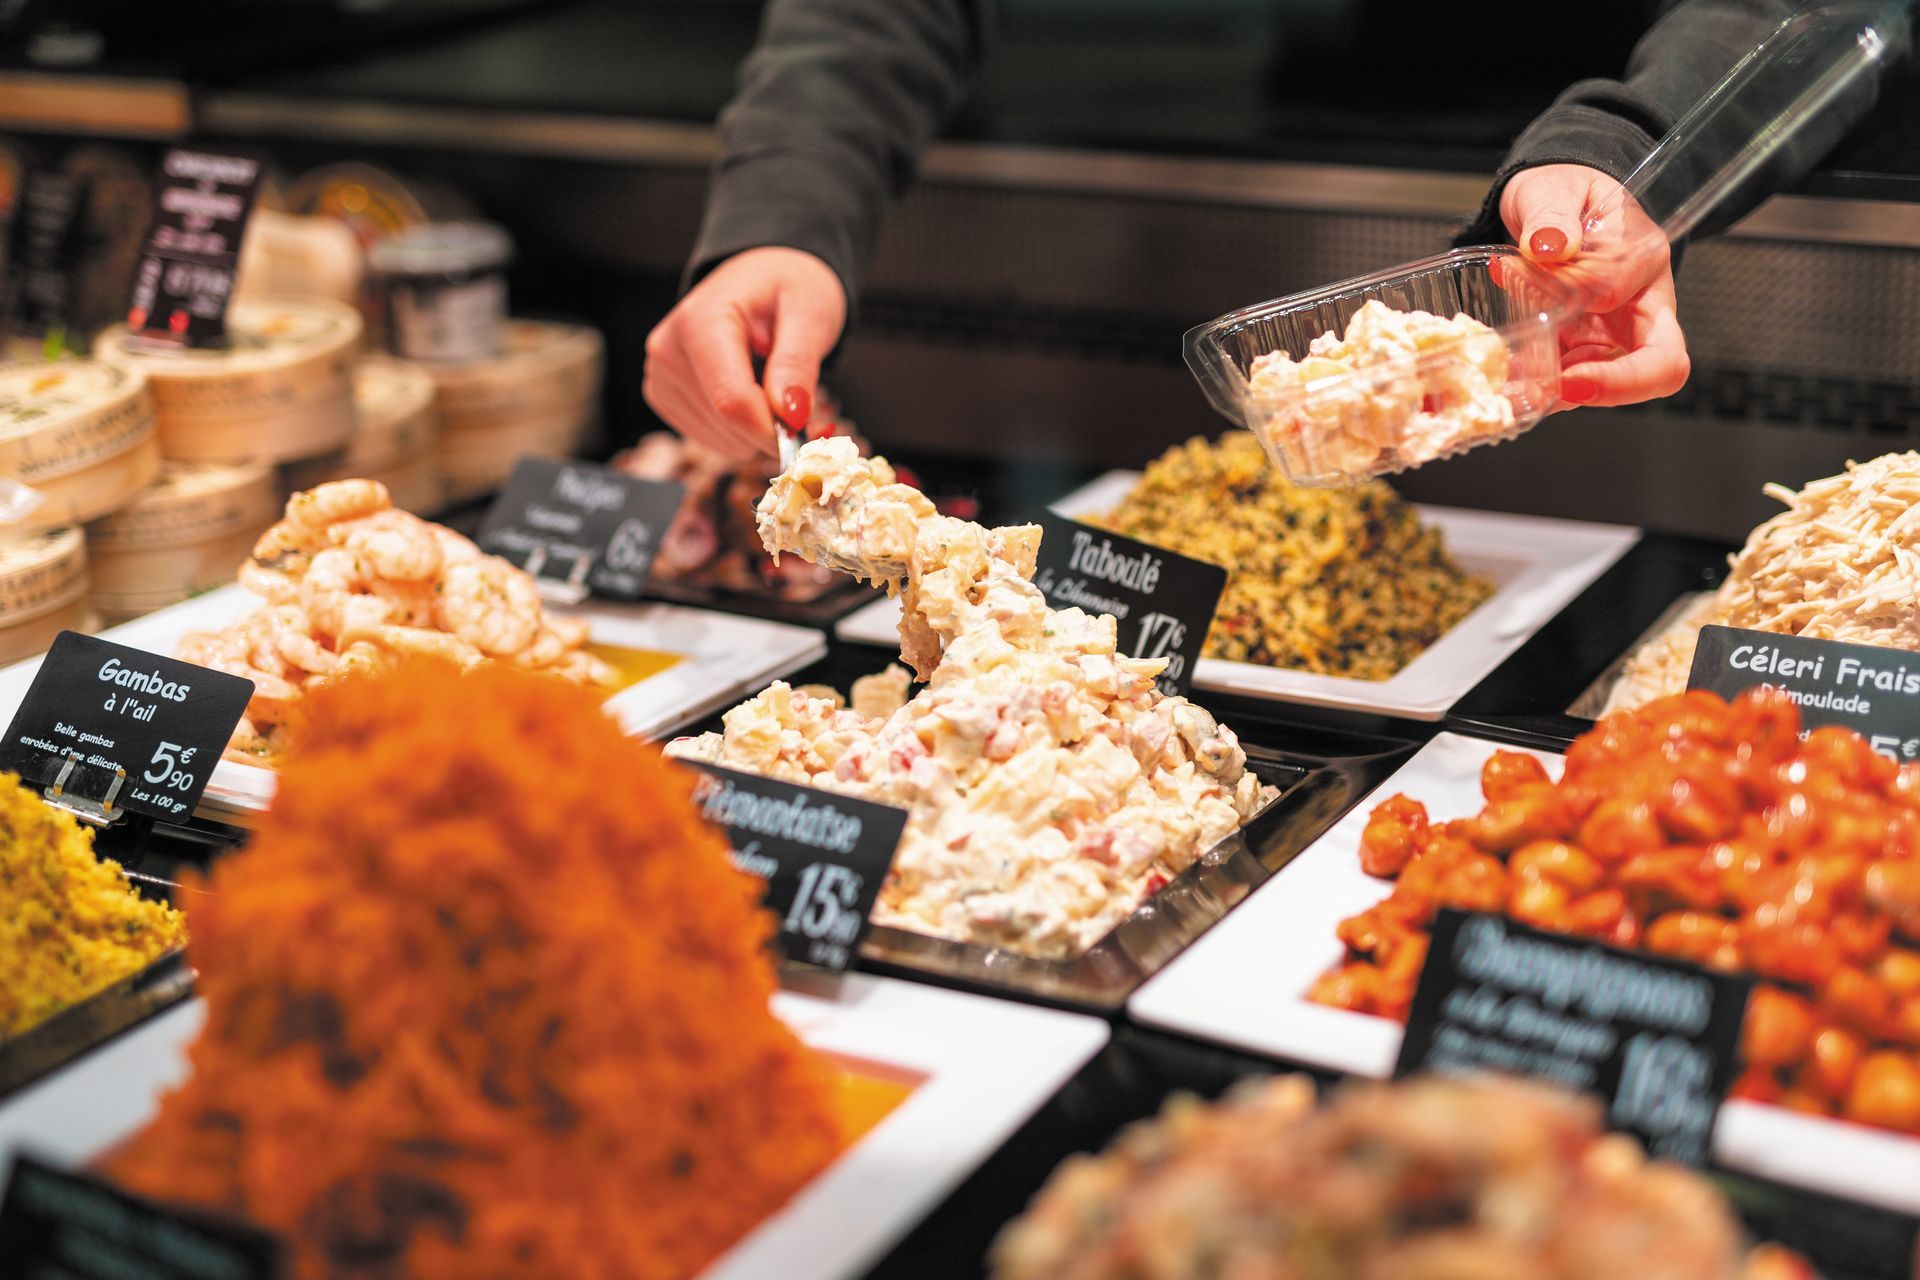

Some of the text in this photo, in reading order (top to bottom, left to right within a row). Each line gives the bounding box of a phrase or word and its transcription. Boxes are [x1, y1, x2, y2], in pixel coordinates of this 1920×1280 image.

[1069, 530, 1162, 594] Taboulé
[98, 658, 191, 703] Gambas
[1729, 645, 1920, 694] Céleri Frais
[103, 693, 117, 711] à
[20, 735, 59, 754] enrobées
[54, 722, 115, 748] Belle gambas
[130, 788, 187, 813] Les 100 gr
